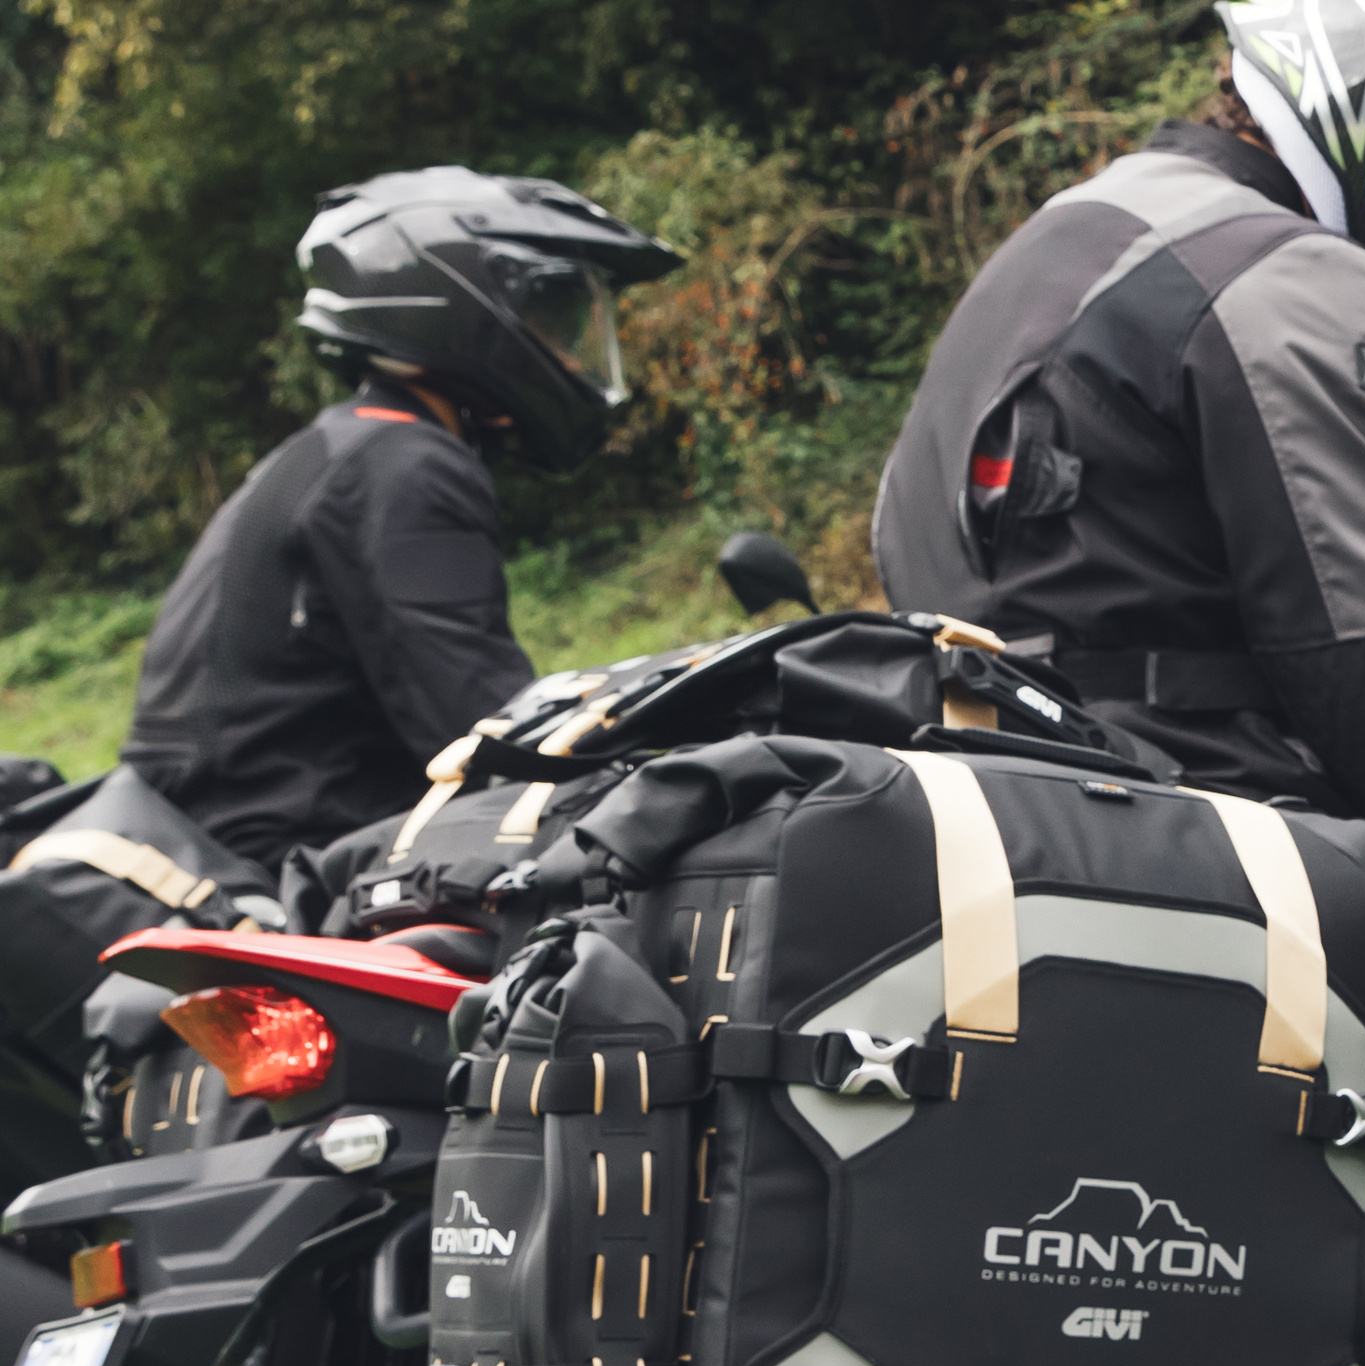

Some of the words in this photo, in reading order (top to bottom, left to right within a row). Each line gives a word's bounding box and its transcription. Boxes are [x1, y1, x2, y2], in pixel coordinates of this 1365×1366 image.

[983, 1226, 1247, 1281] CANYON
[981, 1268, 1081, 1286] DESIGNED
[1089, 1276, 1127, 1289] FOR
[1134, 1280, 1243, 1297] ADVENTURE
[1061, 1306, 1149, 1341] GIVI
